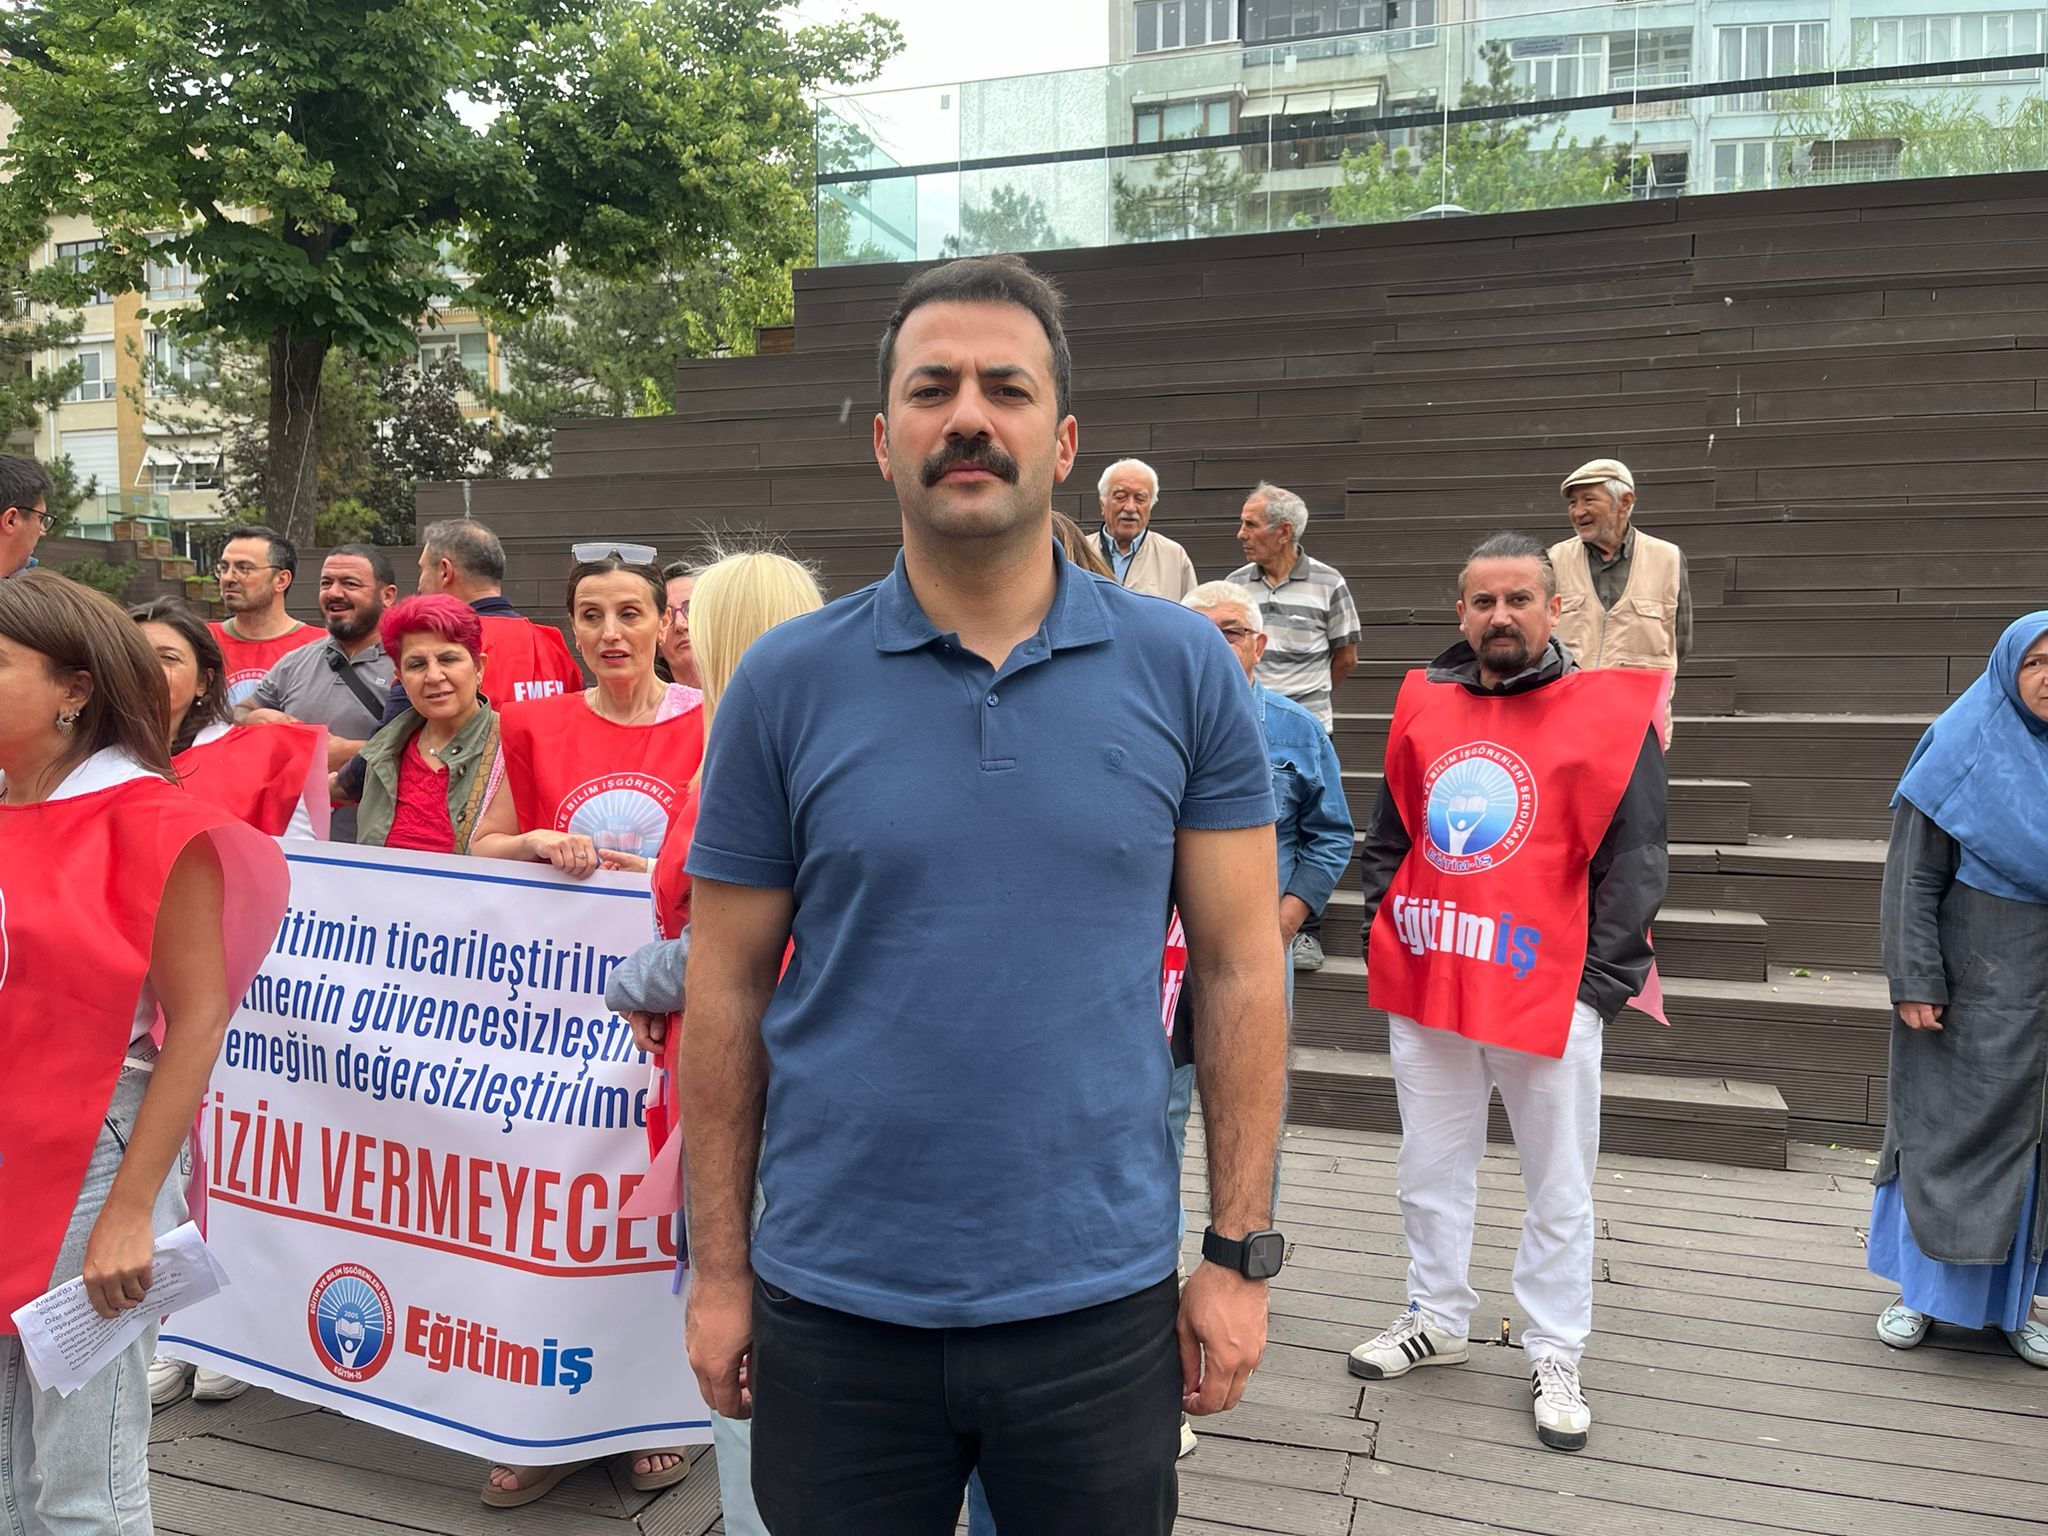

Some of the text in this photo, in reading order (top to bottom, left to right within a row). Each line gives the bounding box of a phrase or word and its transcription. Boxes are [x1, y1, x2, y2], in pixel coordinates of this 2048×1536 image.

[558, 813, 568, 829] VE
[566, 785, 599, 811] BİLİM
[1429, 755, 1457, 780] BİLİM
[1460, 745, 1528, 783] İŞGÖRENLERİ
[1502, 785, 1531, 850] SENDİKASI
[276, 907, 377, 966] itimin
[225, 1028, 328, 1085] emeğin
[213, 1091, 303, 1205] İZİN
[319, 1279, 327, 1289] VE
[378, 1290, 393, 1335] SENDİKASI
